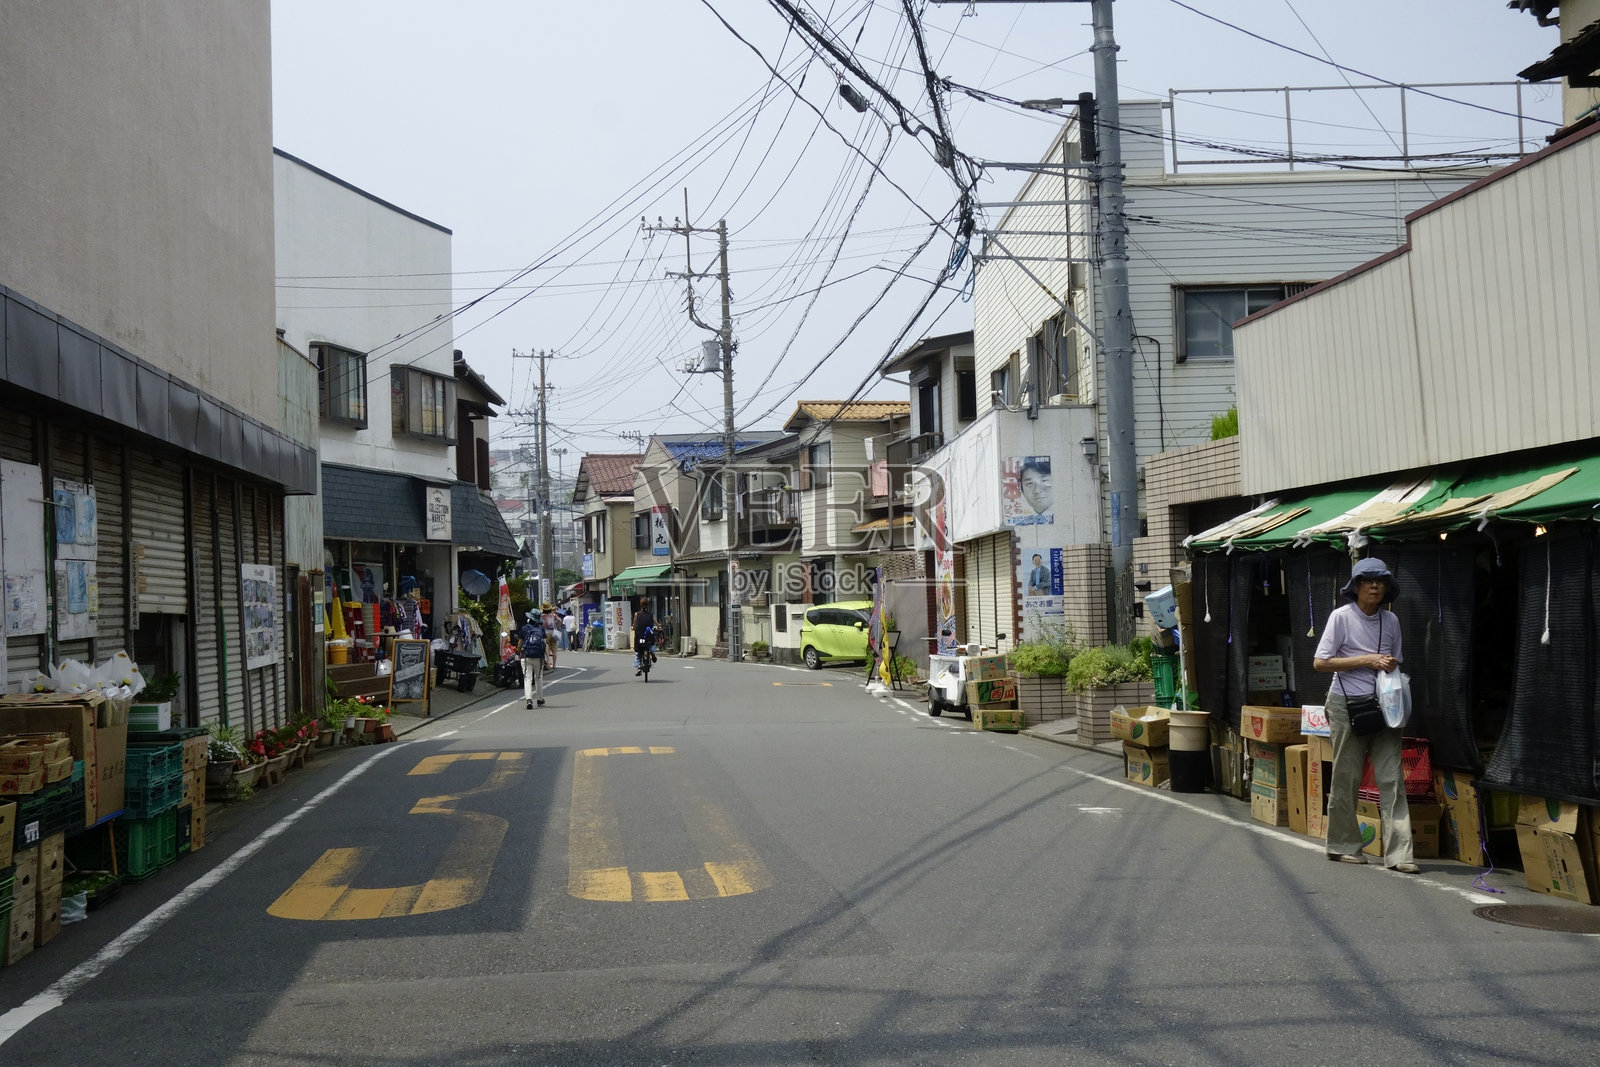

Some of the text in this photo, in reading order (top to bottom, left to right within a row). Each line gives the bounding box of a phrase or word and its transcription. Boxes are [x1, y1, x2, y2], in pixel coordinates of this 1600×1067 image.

[1002, 456, 1021, 503] 山本
[429, 503, 449, 515] COLLECTION
[432, 514, 447, 525] MARKET
[265, 745, 774, 922] 30
